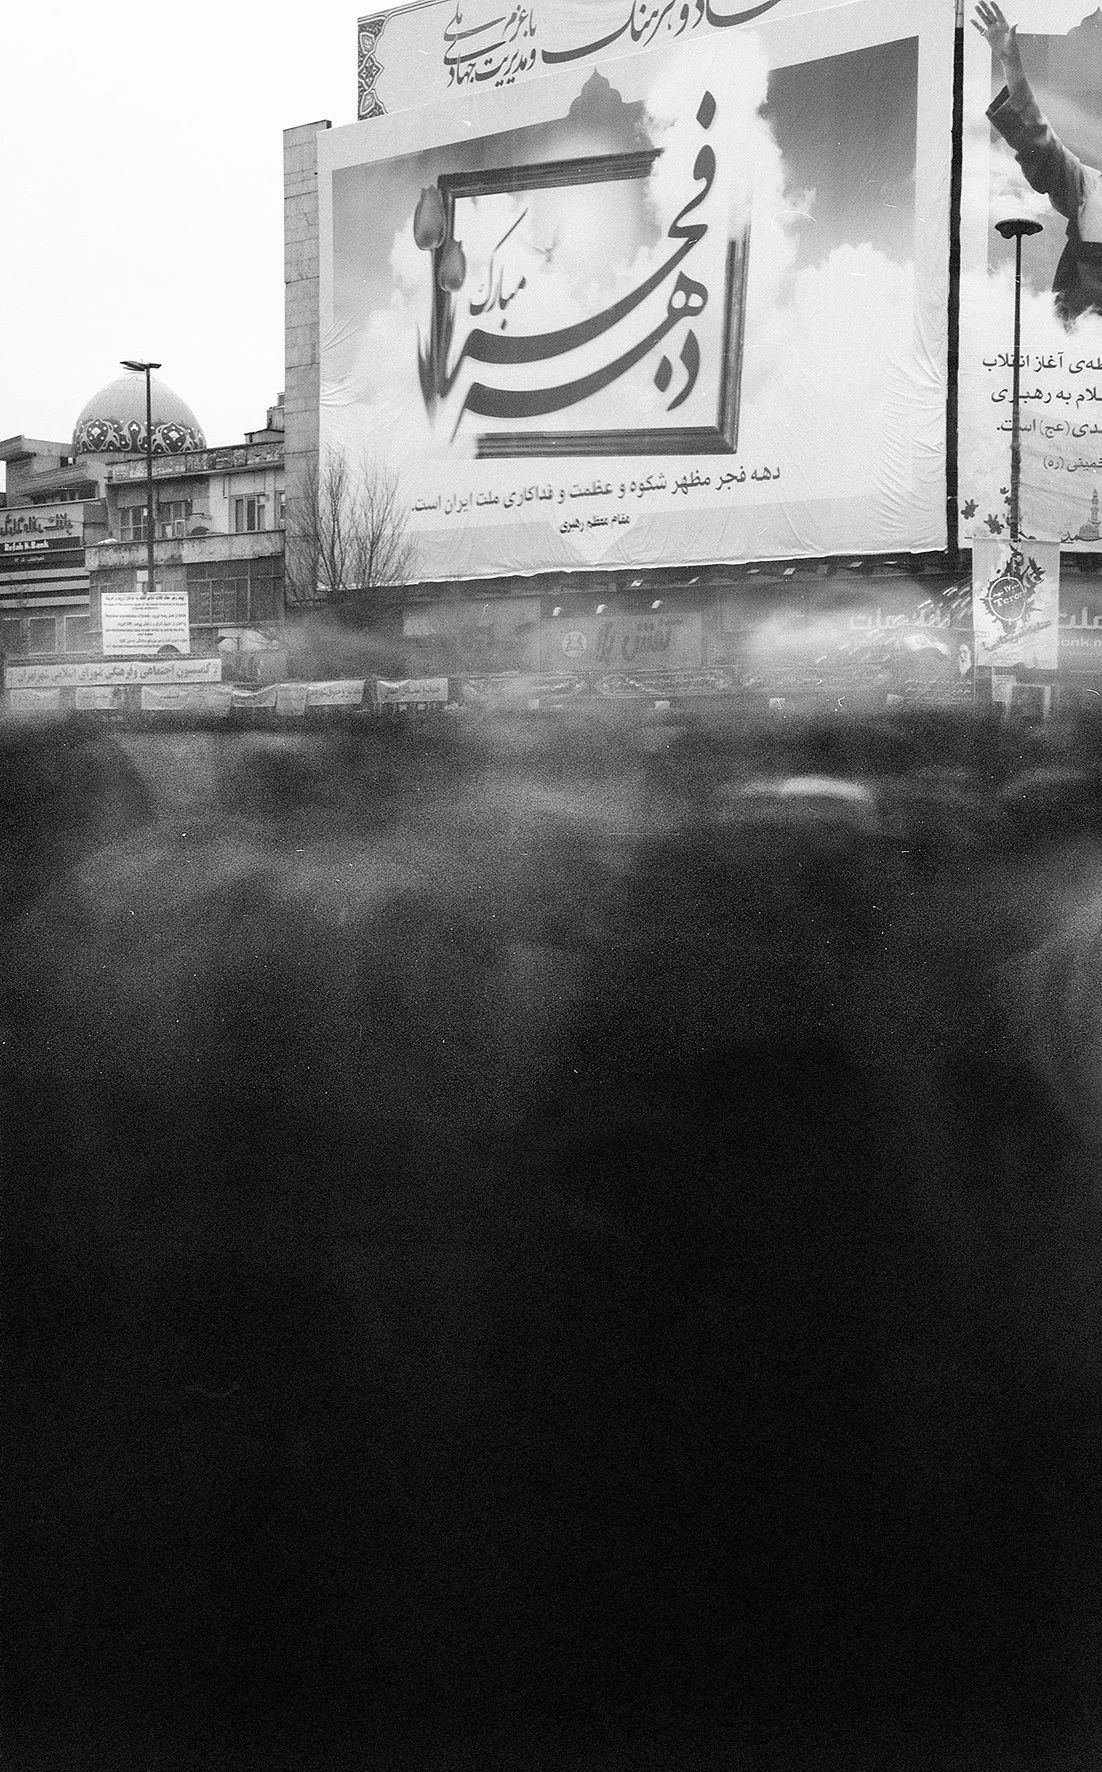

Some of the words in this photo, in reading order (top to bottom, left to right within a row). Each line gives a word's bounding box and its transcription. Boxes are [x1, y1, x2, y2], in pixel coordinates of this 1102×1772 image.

[982, 352, 1030, 372] انلاب
[1034, 351, 1065, 373] آغاز
[1056, 390, 1072, 406] به
[1043, 455, 1064, 471] (ره)
[671, 469, 711, 495] مظهر
[715, 465, 747, 491] فجر
[751, 466, 781, 482] دهه
[570, 479, 613, 499] عظمت
[617, 482, 626, 499] و
[630, 472, 668, 498] شکوه
[444, 492, 473, 515] ایران
[476, 490, 499, 507] ملت
[504, 484, 553, 509] فداکاری
[557, 488, 565, 504] و
[560, 517, 585, 534] رهبری
[1061, 637, 1090, 648] ank
